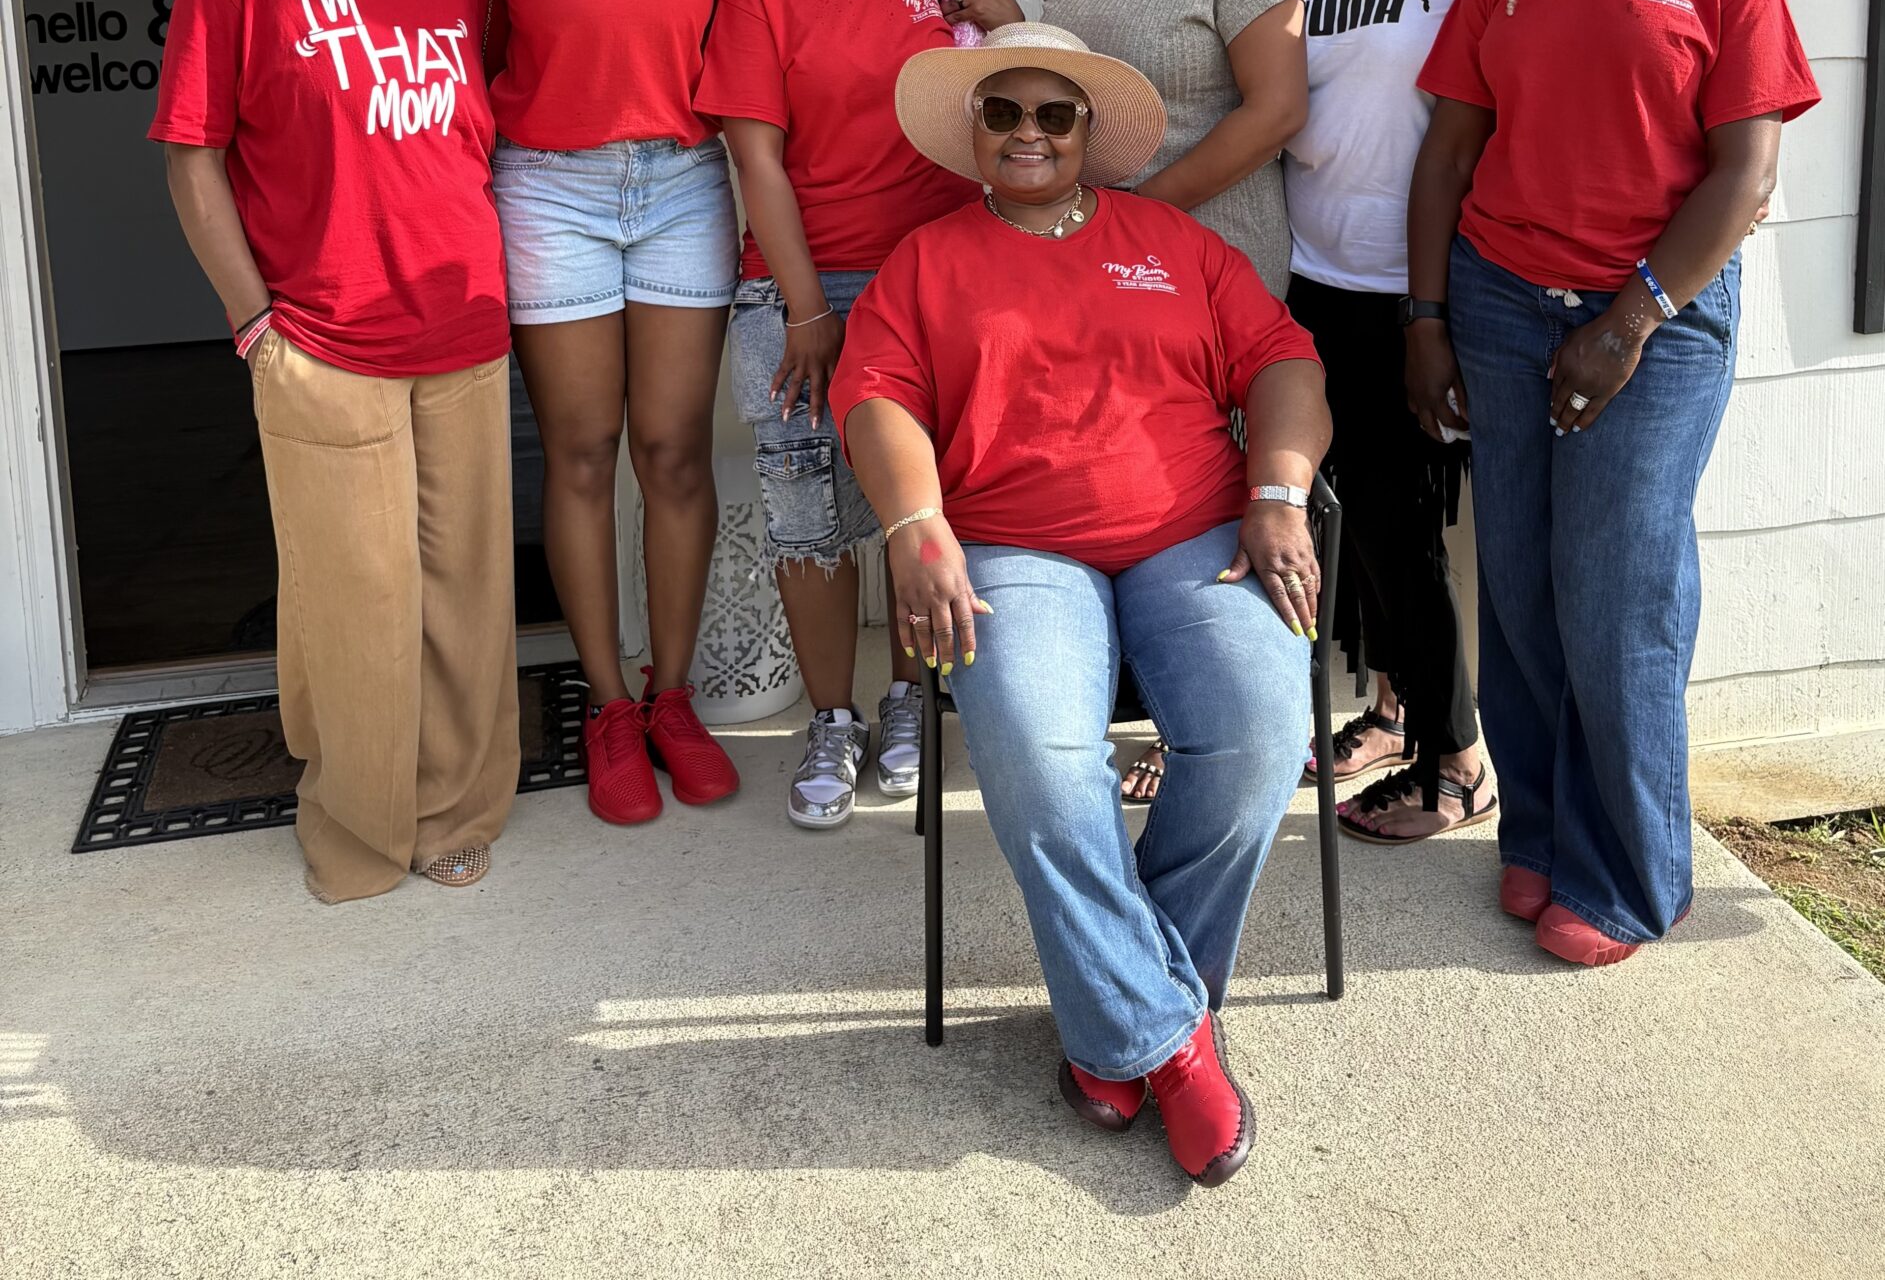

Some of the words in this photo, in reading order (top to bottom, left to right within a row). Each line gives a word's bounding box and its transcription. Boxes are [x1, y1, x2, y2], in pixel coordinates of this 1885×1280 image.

[31, 52, 162, 95] welco
[309, 24, 468, 91] THAT
[1101, 262, 1133, 278] My
[1132, 264, 1170, 279] Bump
